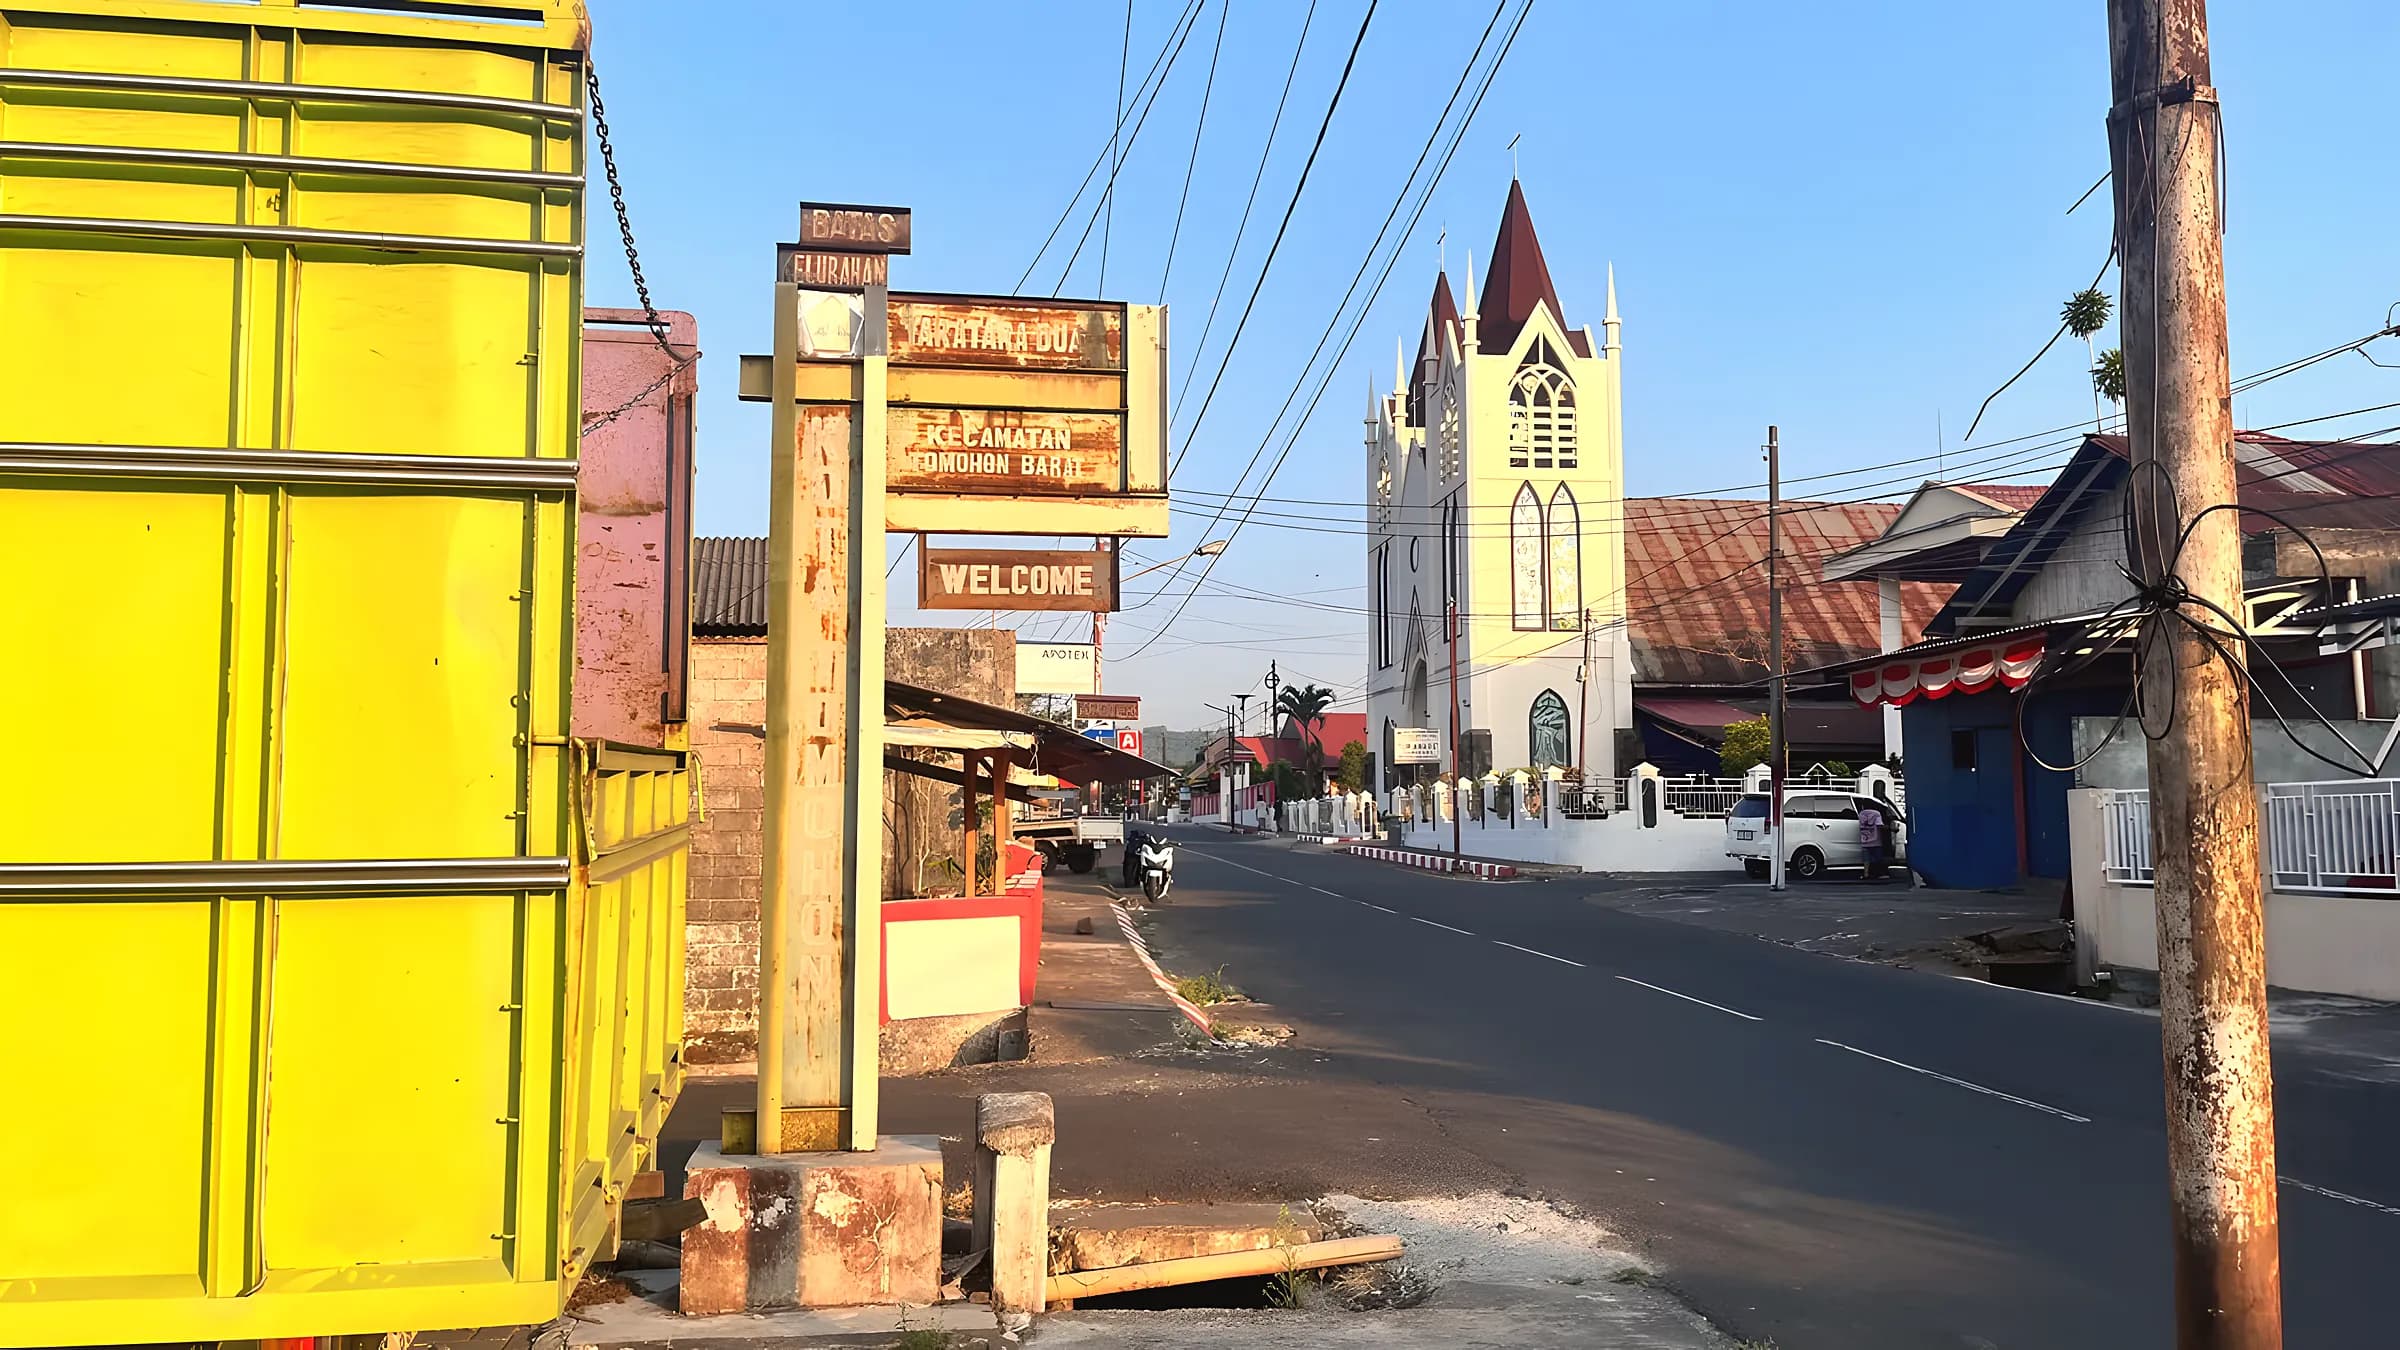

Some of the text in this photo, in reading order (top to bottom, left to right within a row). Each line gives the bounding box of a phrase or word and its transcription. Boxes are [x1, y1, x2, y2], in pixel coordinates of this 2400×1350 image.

[813, 209, 897, 242] BATAS
[927, 424, 1071, 450] KECAMATAN
[907, 451, 1010, 475] TOMOHON
[939, 563, 1094, 596] WELCOME
[1122, 733, 1135, 749] A
